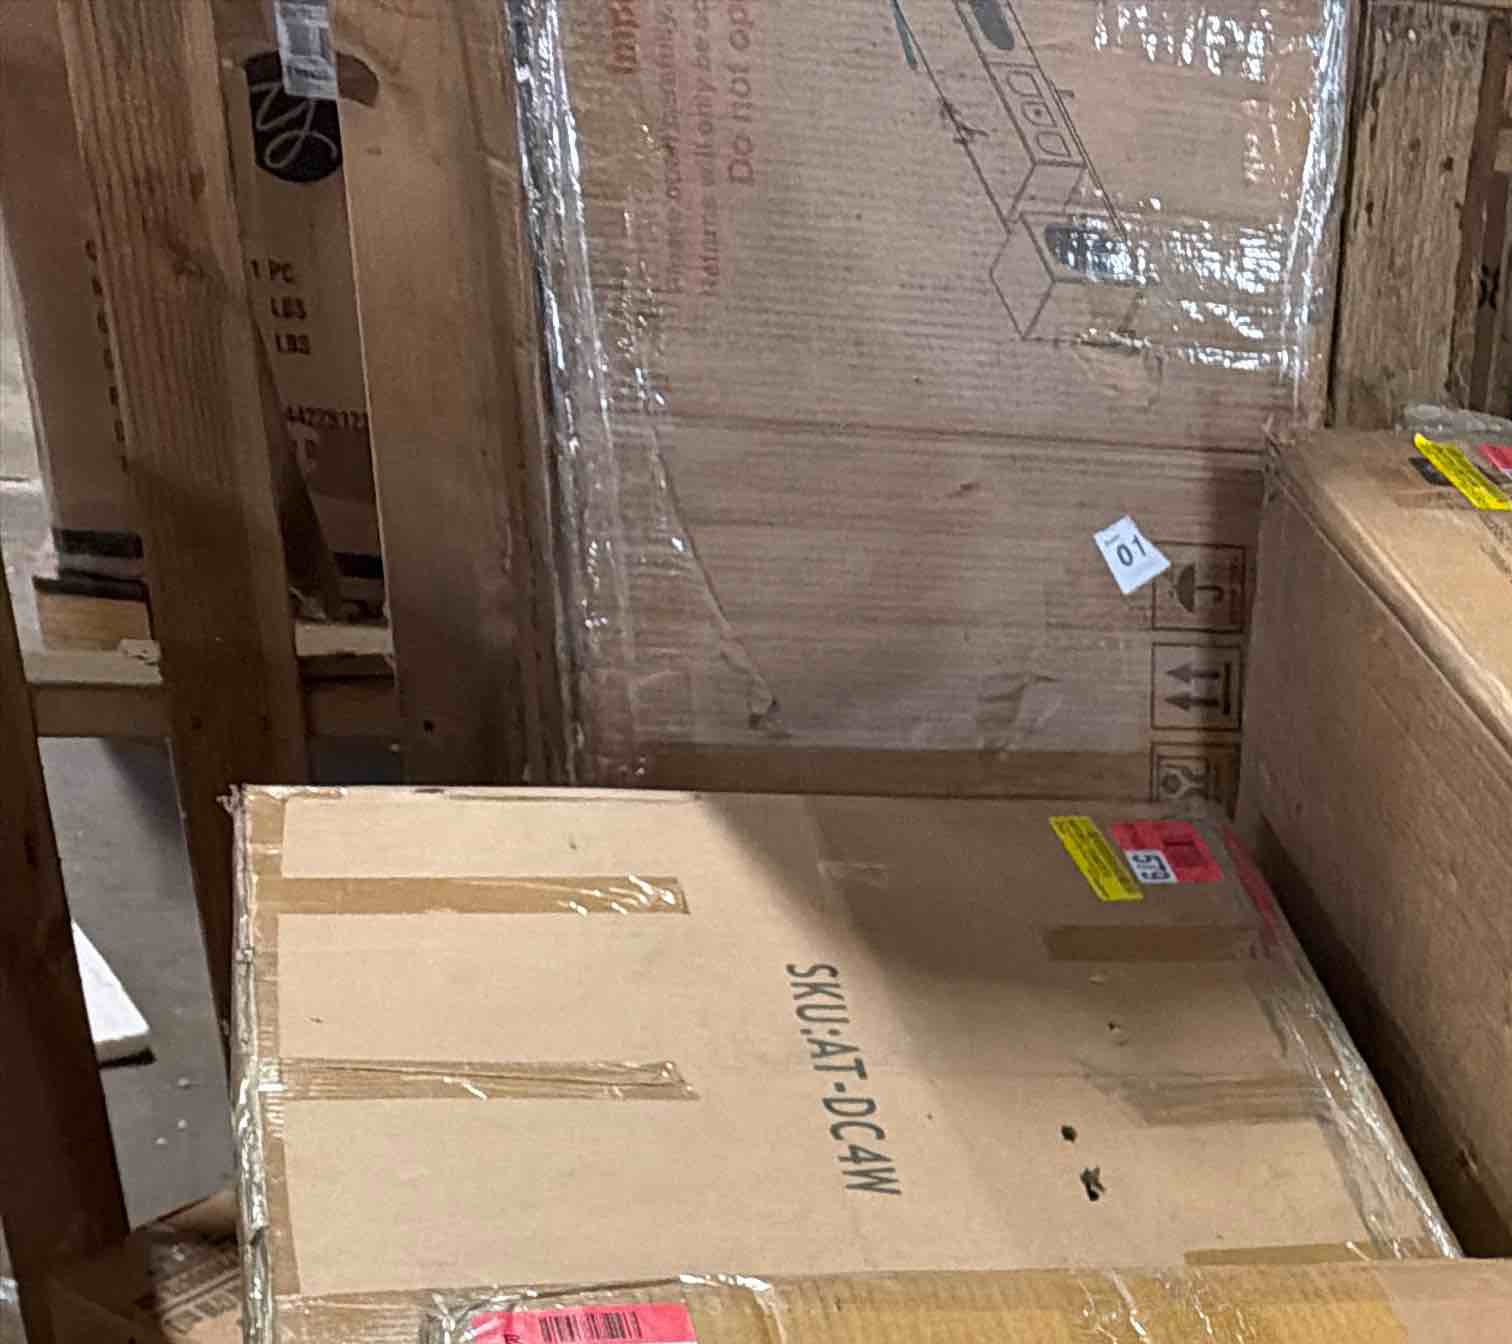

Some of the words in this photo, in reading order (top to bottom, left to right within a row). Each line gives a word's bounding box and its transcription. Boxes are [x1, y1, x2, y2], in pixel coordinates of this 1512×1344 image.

[726, 63, 754, 123] not
[726, 135, 755, 187] Do
[1116, 533, 1146, 567] 01
[786, 963, 902, 1196] SKU:AT-DC4W
